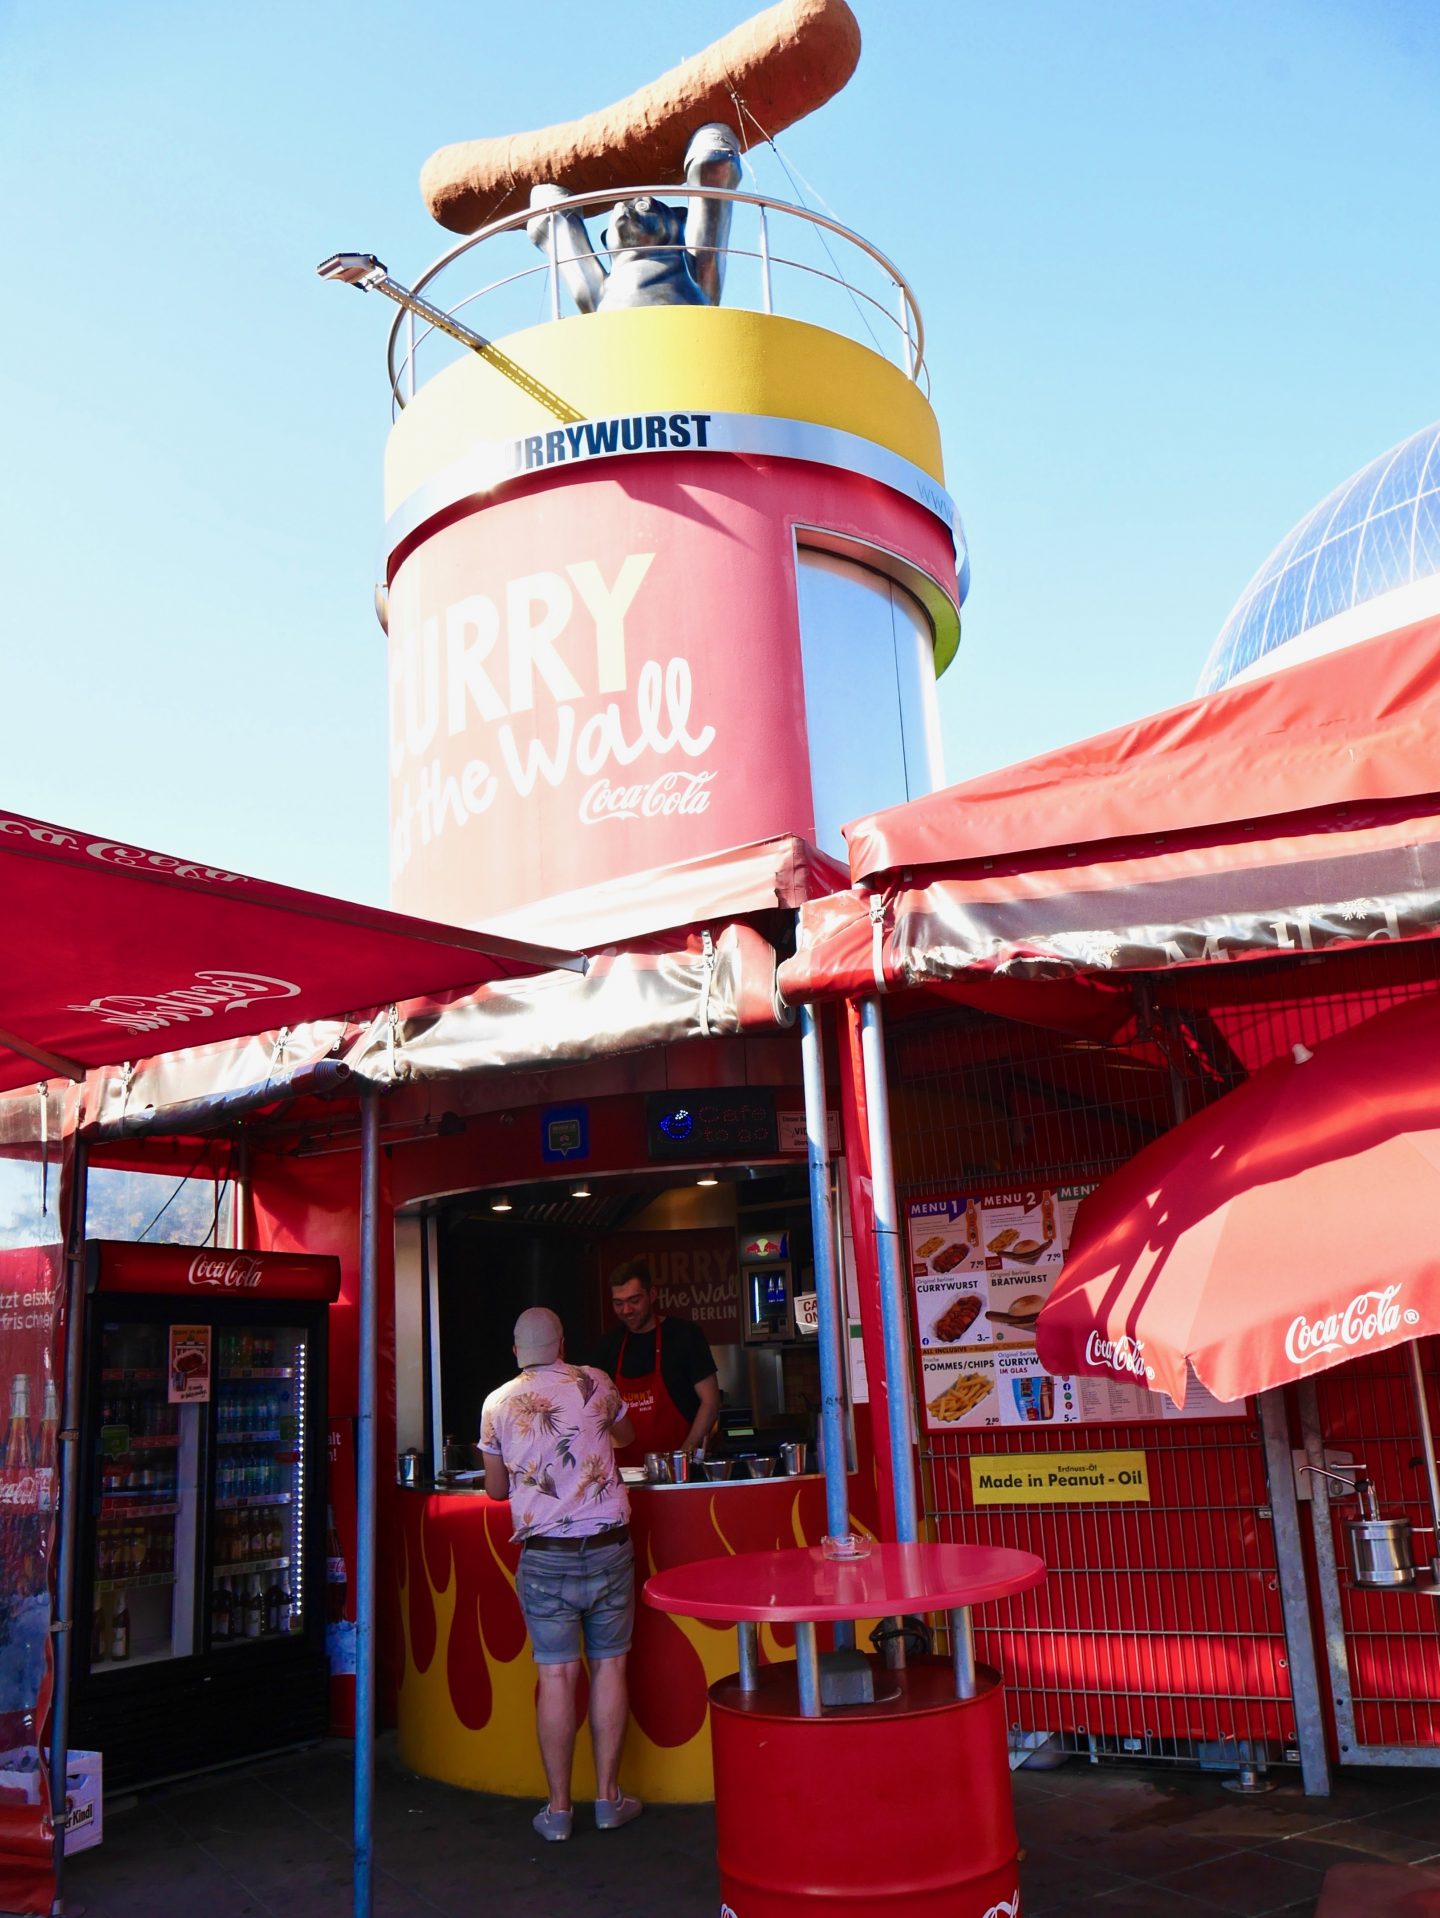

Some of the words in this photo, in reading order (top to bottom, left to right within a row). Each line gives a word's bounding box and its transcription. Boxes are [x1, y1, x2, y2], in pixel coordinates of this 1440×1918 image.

[504, 414, 711, 474] URRYWURST
[392, 552, 657, 776] URRY
[417, 758, 499, 846] the
[498, 656, 717, 797] Wall
[579, 769, 719, 825] Coca-Cola
[911, 1202, 948, 1216] MENU
[951, 1200, 959, 1214] 1
[984, 1193, 1022, 1207] MENU
[1026, 1192, 1037, 1205] 2
[188, 1252, 266, 1288] Coca-Cola
[632, 1249, 733, 1285] URRY
[917, 1280, 979, 1294] CURRYWURST
[991, 1274, 1048, 1288] BRATWURST
[0, 1292, 20, 1309] tzt
[657, 1286, 691, 1310] the
[803, 1300, 818, 1313] CA
[691, 1305, 738, 1321] BERLIN
[805, 1312, 818, 1324] ON
[1284, 1282, 1403, 1365] Coca-Cola
[923, 1347, 934, 1355] ALL
[935, 1346, 967, 1354] INCLUSIVE
[1086, 1330, 1146, 1376] Coca-Cola
[924, 1360, 995, 1372] POMMES/CHIPS
[998, 1356, 1040, 1367] CURRYW
[1058, 1463, 1097, 1473] Erdnuss-Öl
[979, 1474, 1023, 1489] Made
[1028, 1474, 1043, 1488] in
[1049, 1472, 1105, 1487] Peanut
[1118, 1470, 1143, 1485] Oil
[72, 1803, 93, 1826] Kindl
